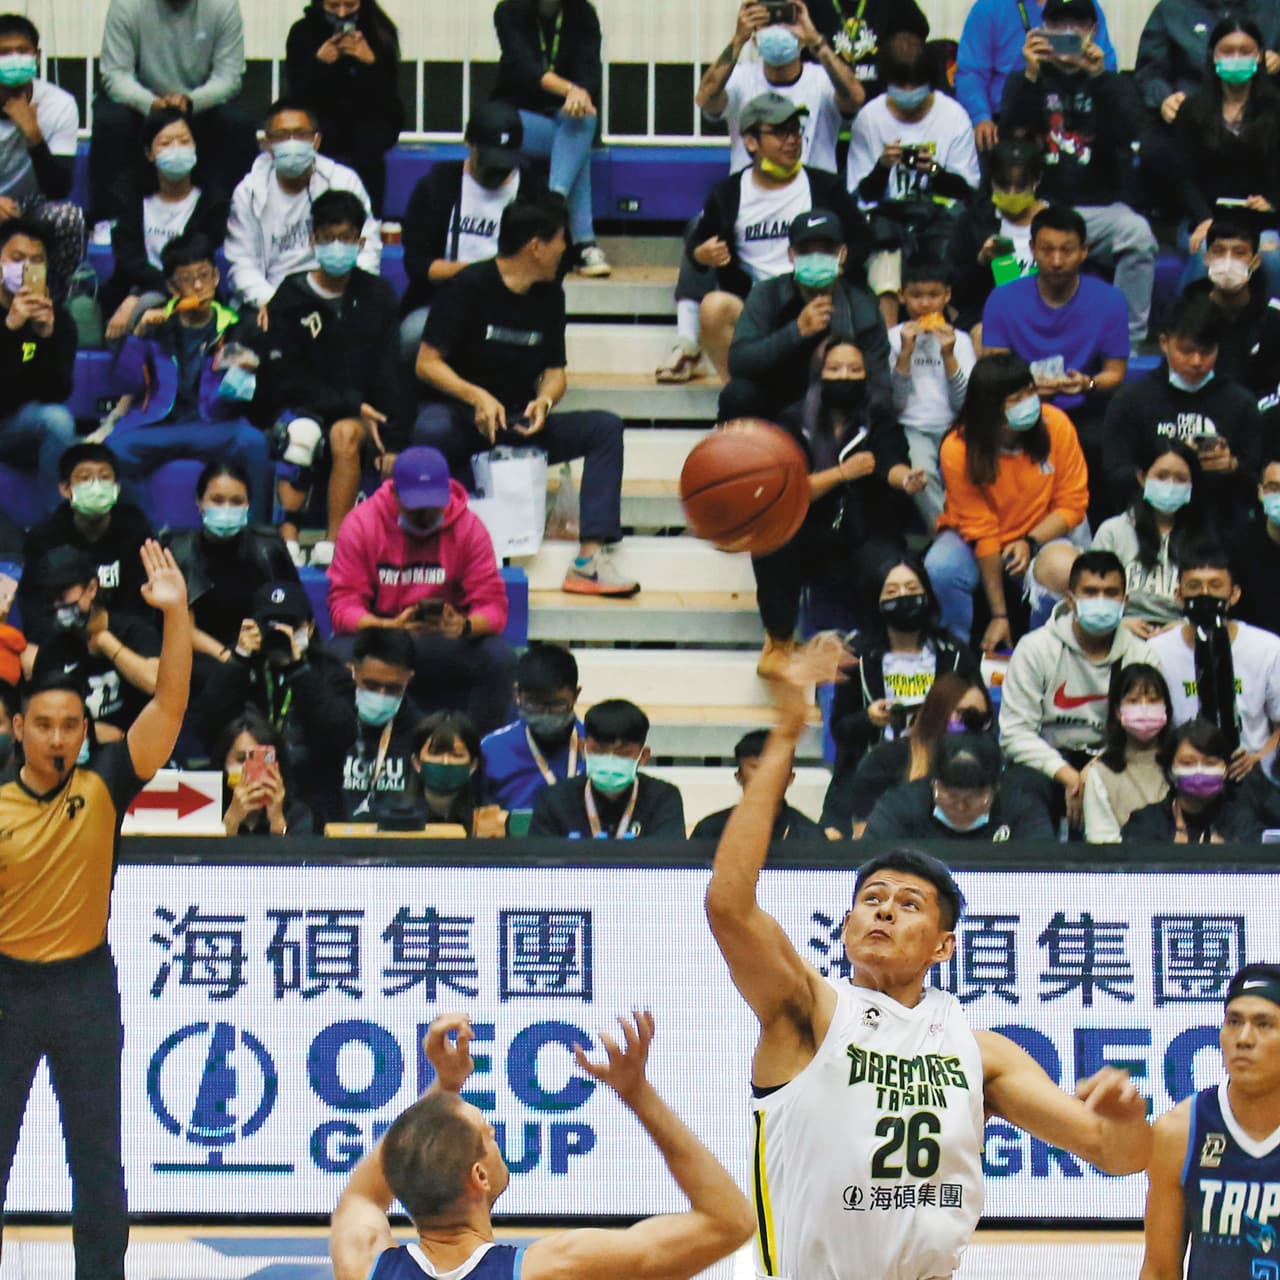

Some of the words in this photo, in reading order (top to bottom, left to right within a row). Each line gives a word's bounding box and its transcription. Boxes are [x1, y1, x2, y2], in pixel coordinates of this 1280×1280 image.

[150, 905, 593, 1003] 海碩集團
[306, 1018, 598, 1114] OEC
[310, 1119, 598, 1175] GUP
[871, 1111, 942, 1180] 26
[869, 1183, 964, 1212] 海碩集團
